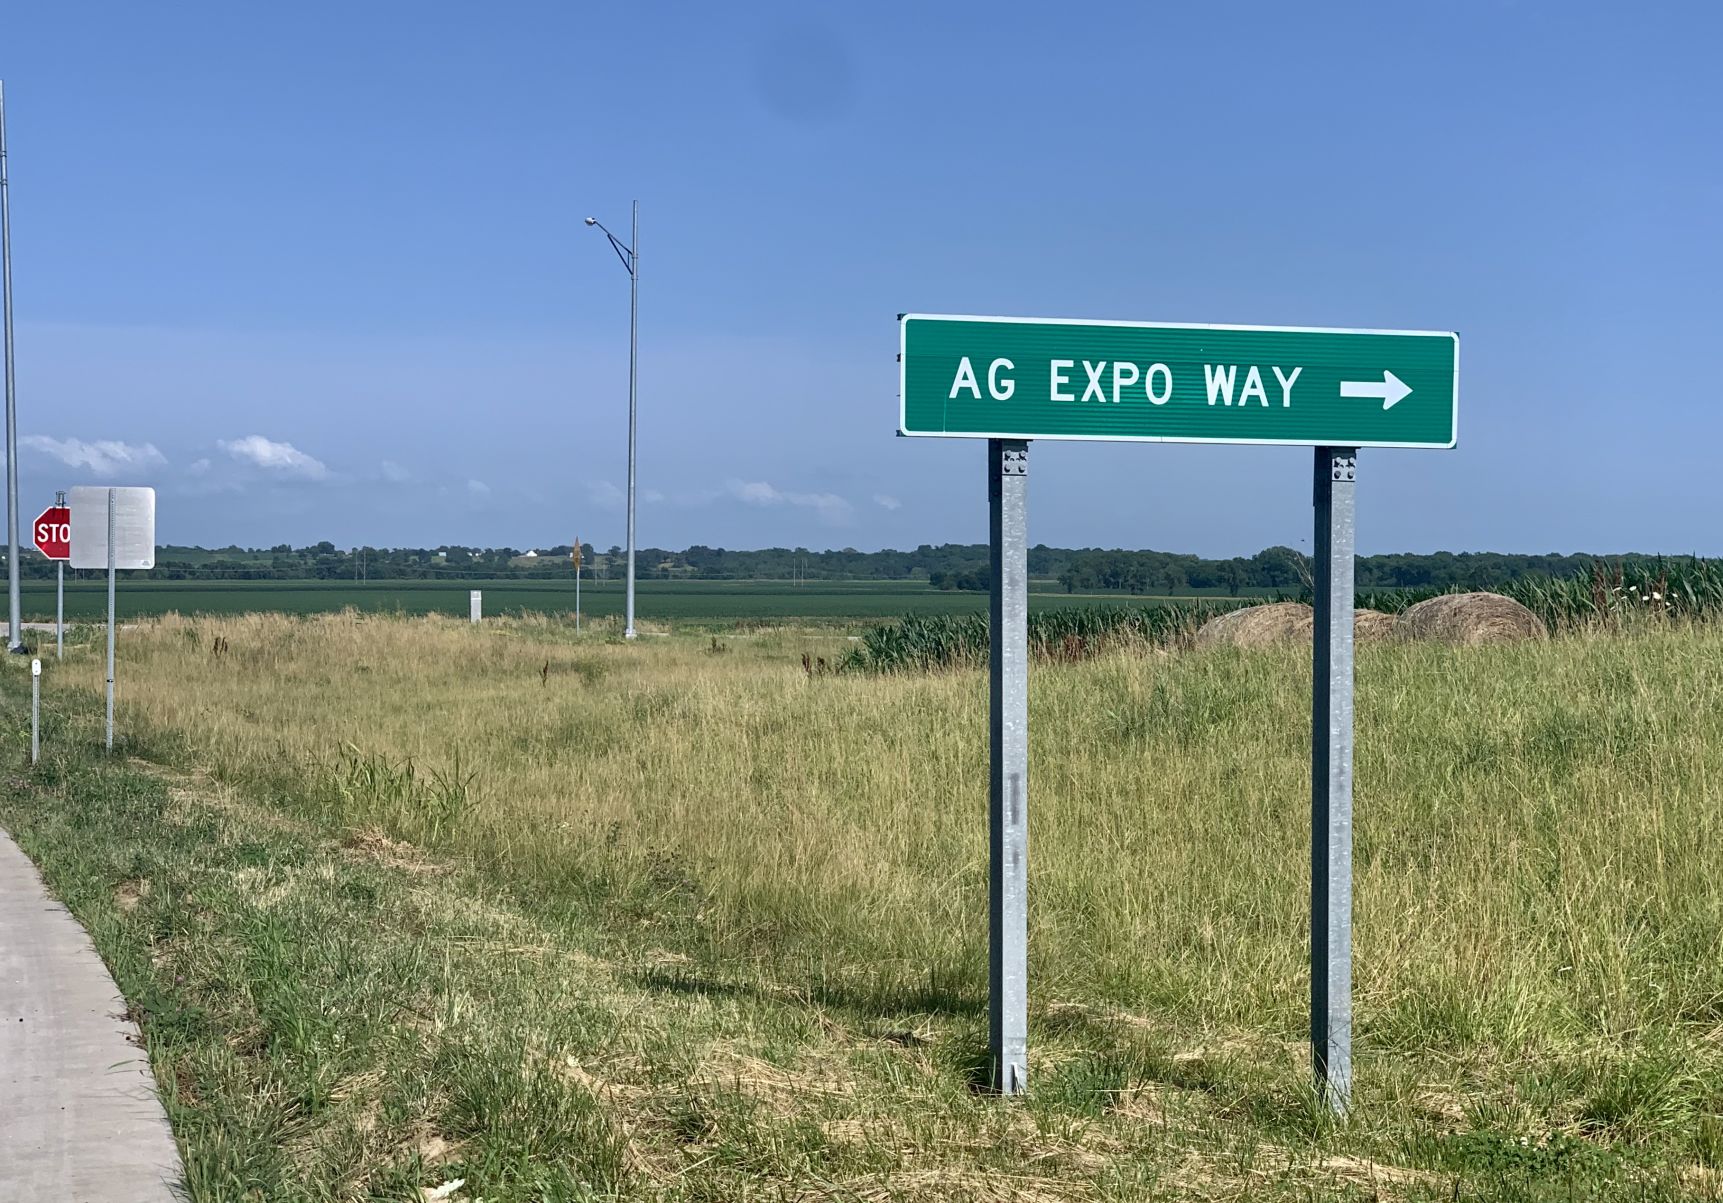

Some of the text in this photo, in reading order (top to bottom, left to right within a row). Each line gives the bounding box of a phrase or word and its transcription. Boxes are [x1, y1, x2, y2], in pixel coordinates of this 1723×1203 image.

[948, 356, 1303, 408] AG EXPO WAY
[37, 523, 70, 543] STO
